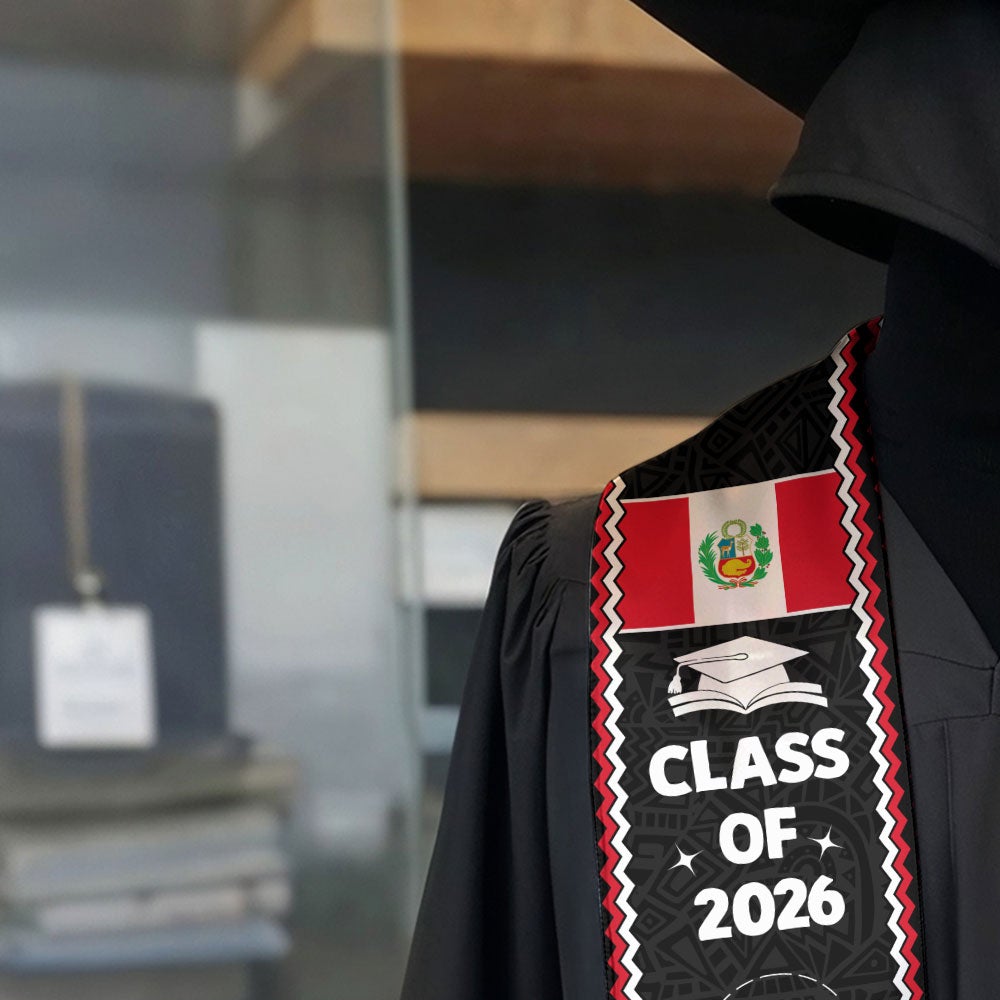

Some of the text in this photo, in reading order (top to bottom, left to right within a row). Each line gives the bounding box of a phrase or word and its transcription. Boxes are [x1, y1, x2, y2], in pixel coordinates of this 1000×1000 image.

[648, 727, 850, 797] CLASS
[718, 806, 798, 865] OF
[693, 874, 846, 942] 2026
